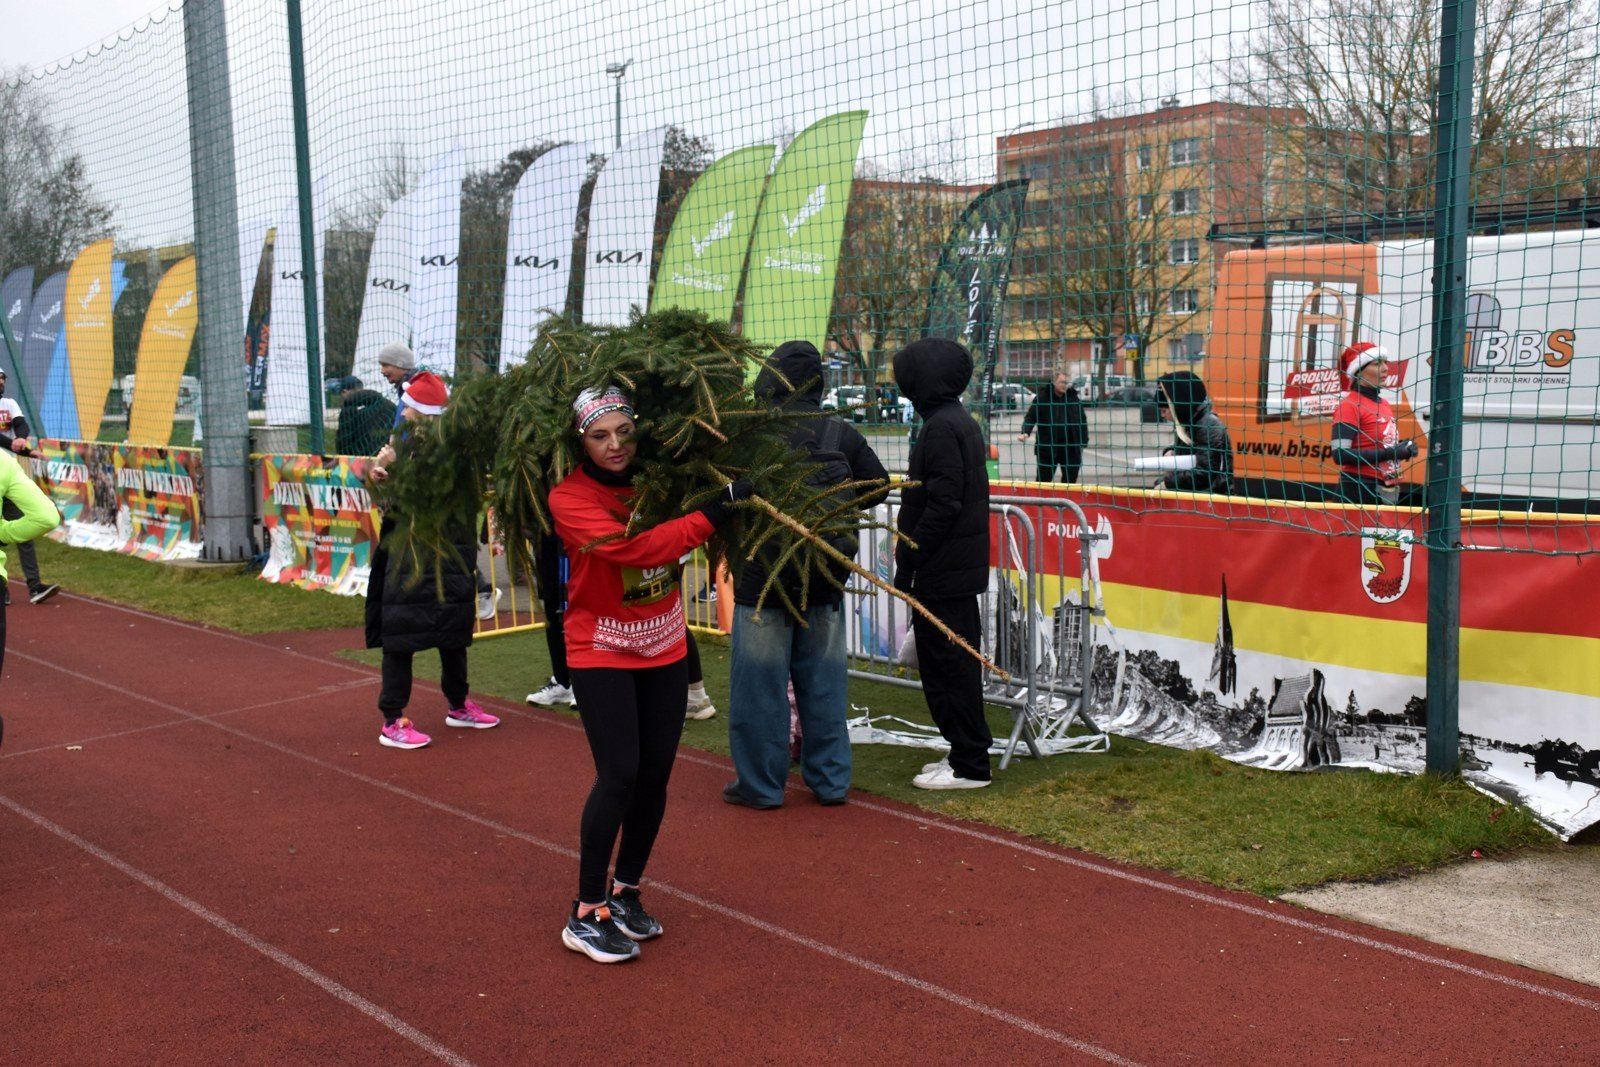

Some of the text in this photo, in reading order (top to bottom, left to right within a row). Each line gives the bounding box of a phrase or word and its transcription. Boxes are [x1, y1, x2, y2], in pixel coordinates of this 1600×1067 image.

[515, 254, 560, 270] KIA
[597, 250, 643, 264] KIA
[1476, 329, 1576, 368] BBS
[1291, 369, 1341, 386] PRODUC
[1463, 376, 1492, 384] DUCENT
[1494, 376, 1531, 385] STOLARKI
[1236, 439, 1333, 462] www.bbsp
